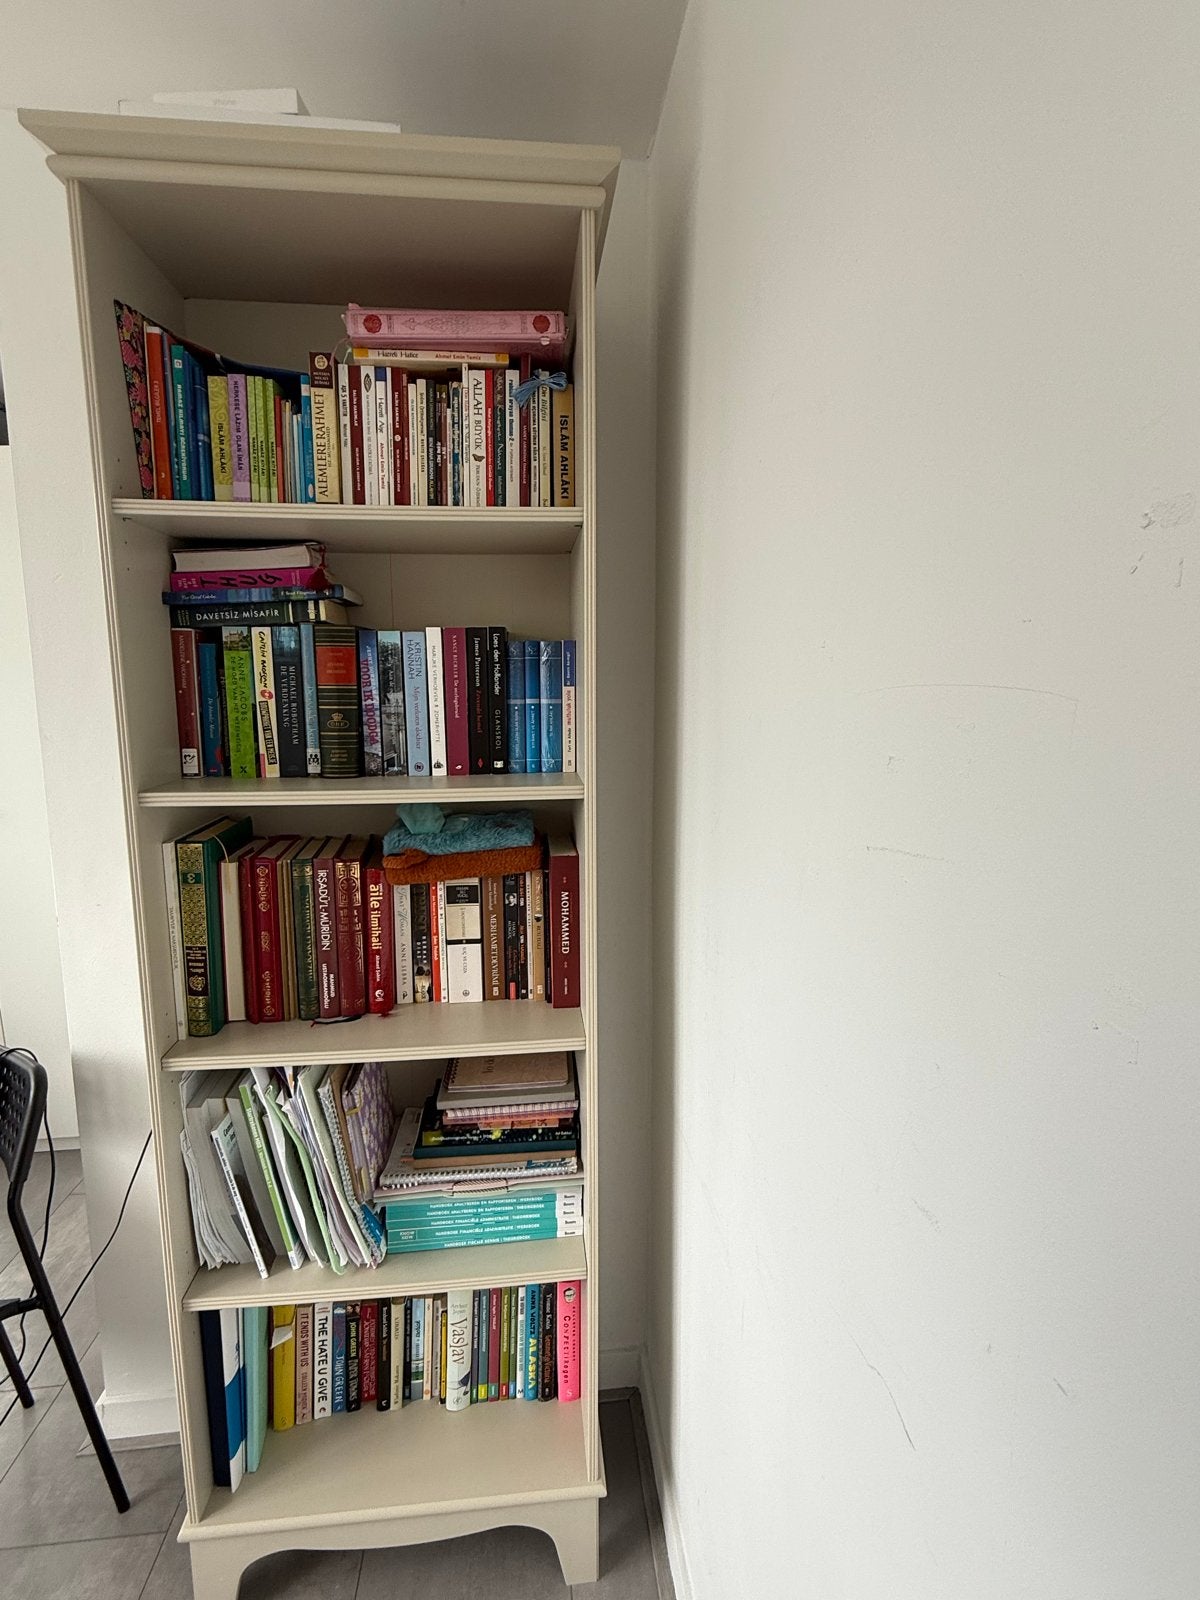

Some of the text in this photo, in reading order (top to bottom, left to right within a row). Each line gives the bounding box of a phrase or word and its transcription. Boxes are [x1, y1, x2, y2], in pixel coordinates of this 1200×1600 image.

[474, 378, 483, 450] ALLAH BÜYÜK
[540, 399, 548, 422] Bilgisi
[314, 392, 329, 497] ALEMLERE RAHMET
[560, 415, 570, 499] İSLÂM AHLÂKI
[196, 606, 280, 621] DAVETSİZ MİSAFİR
[237, 656, 245, 681] ANNE
[360, 658, 371, 688] VOOR
[406, 640, 415, 680] HANNAH
[414, 642, 422, 677] KRISTIN
[280, 666, 289, 728] DE VERDENKING
[288, 666, 298, 744] MICHAEL ROBOTHAM
[364, 690, 372, 702] IK
[365, 703, 379, 746] DOODGA
[370, 884, 382, 950] aile ilmihali
[490, 914, 498, 954] MERHAMET
[560, 891, 570, 954] MOHAMMED
[491, 956, 500, 985] DEVRİMİ
[318, 1316, 328, 1336] THE
[450, 1317, 468, 1364] Vaslav
[300, 1340, 308, 1358] WITH
[300, 1358, 308, 1367] US
[318, 1339, 328, 1366] HATE
[528, 1338, 537, 1389] ALASKA
[334, 1355, 344, 1402] JOHN GREEN
[348, 1360, 358, 1378] PAPER
[318, 1378, 328, 1402] GIVE
